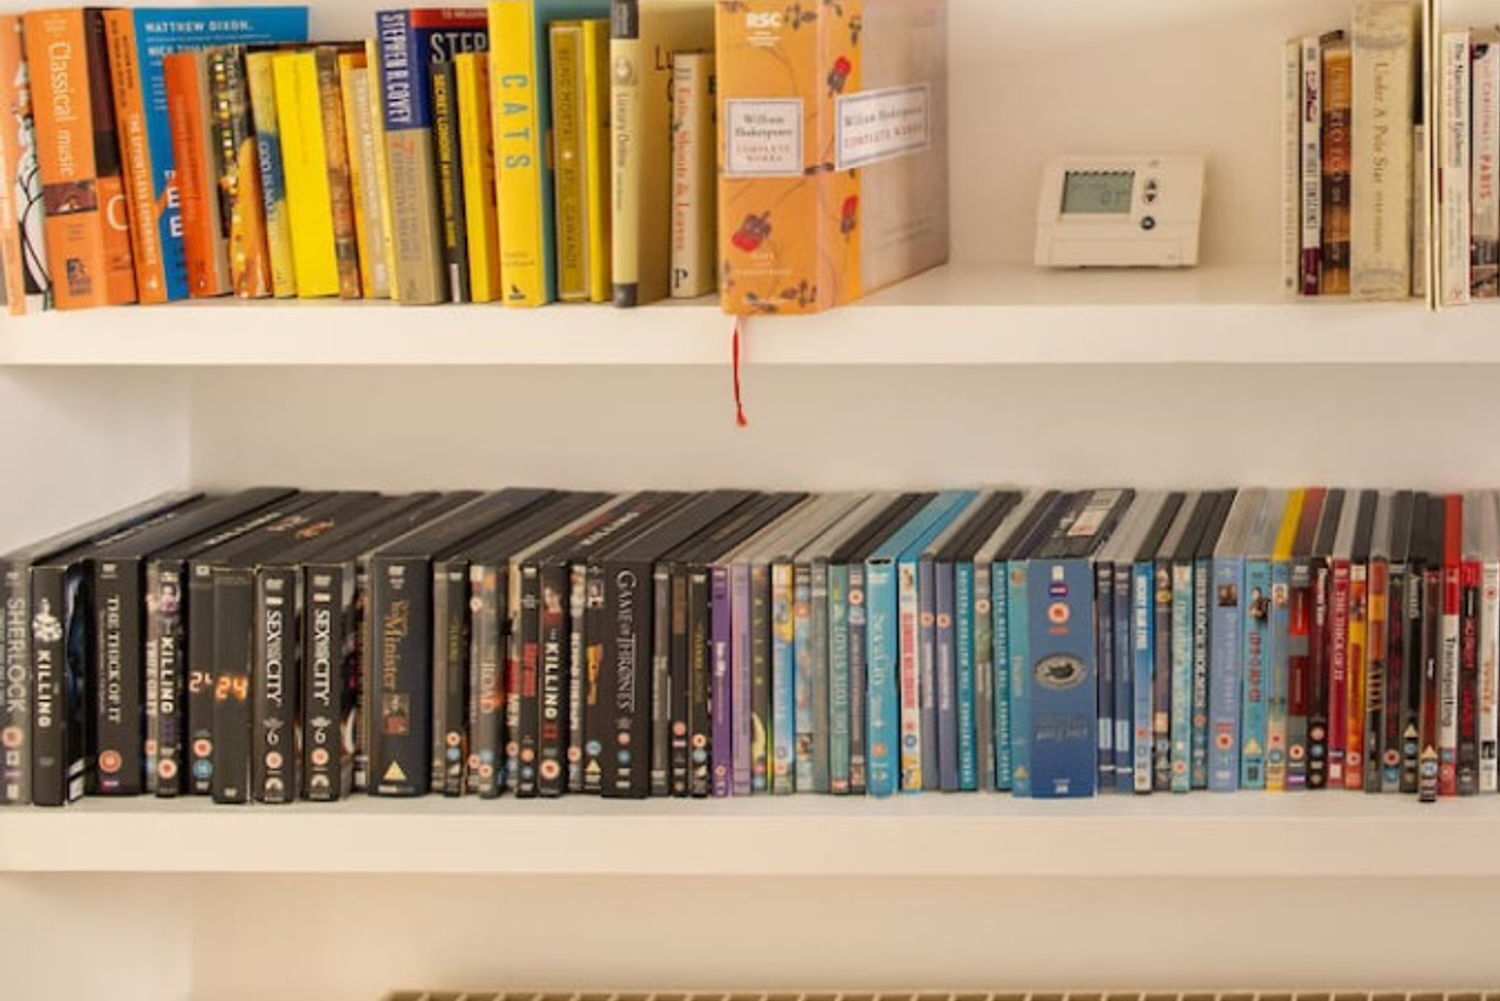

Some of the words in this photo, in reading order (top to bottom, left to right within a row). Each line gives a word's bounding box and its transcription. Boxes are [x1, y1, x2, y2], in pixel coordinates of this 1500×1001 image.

[382, 13, 410, 68] STEPHEN
[746, 11, 782, 29] RSC
[48, 42, 77, 123] Classical
[1374, 62, 1389, 103] Under
[501, 74, 531, 169] CATS
[59, 129, 77, 177] music
[107, 596, 120, 630] THE
[266, 610, 281, 642] SEX
[315, 609, 330, 642] SEX
[6, 598, 26, 713] SHERLOCK
[160, 636, 175, 714] KILLING
[544, 642, 559, 719] KILLING
[38, 649, 52, 727] KILLING
[215, 673, 249, 700] 24
[266, 660, 280, 704] CITY
[1442, 637, 1456, 728] Trainspotting
